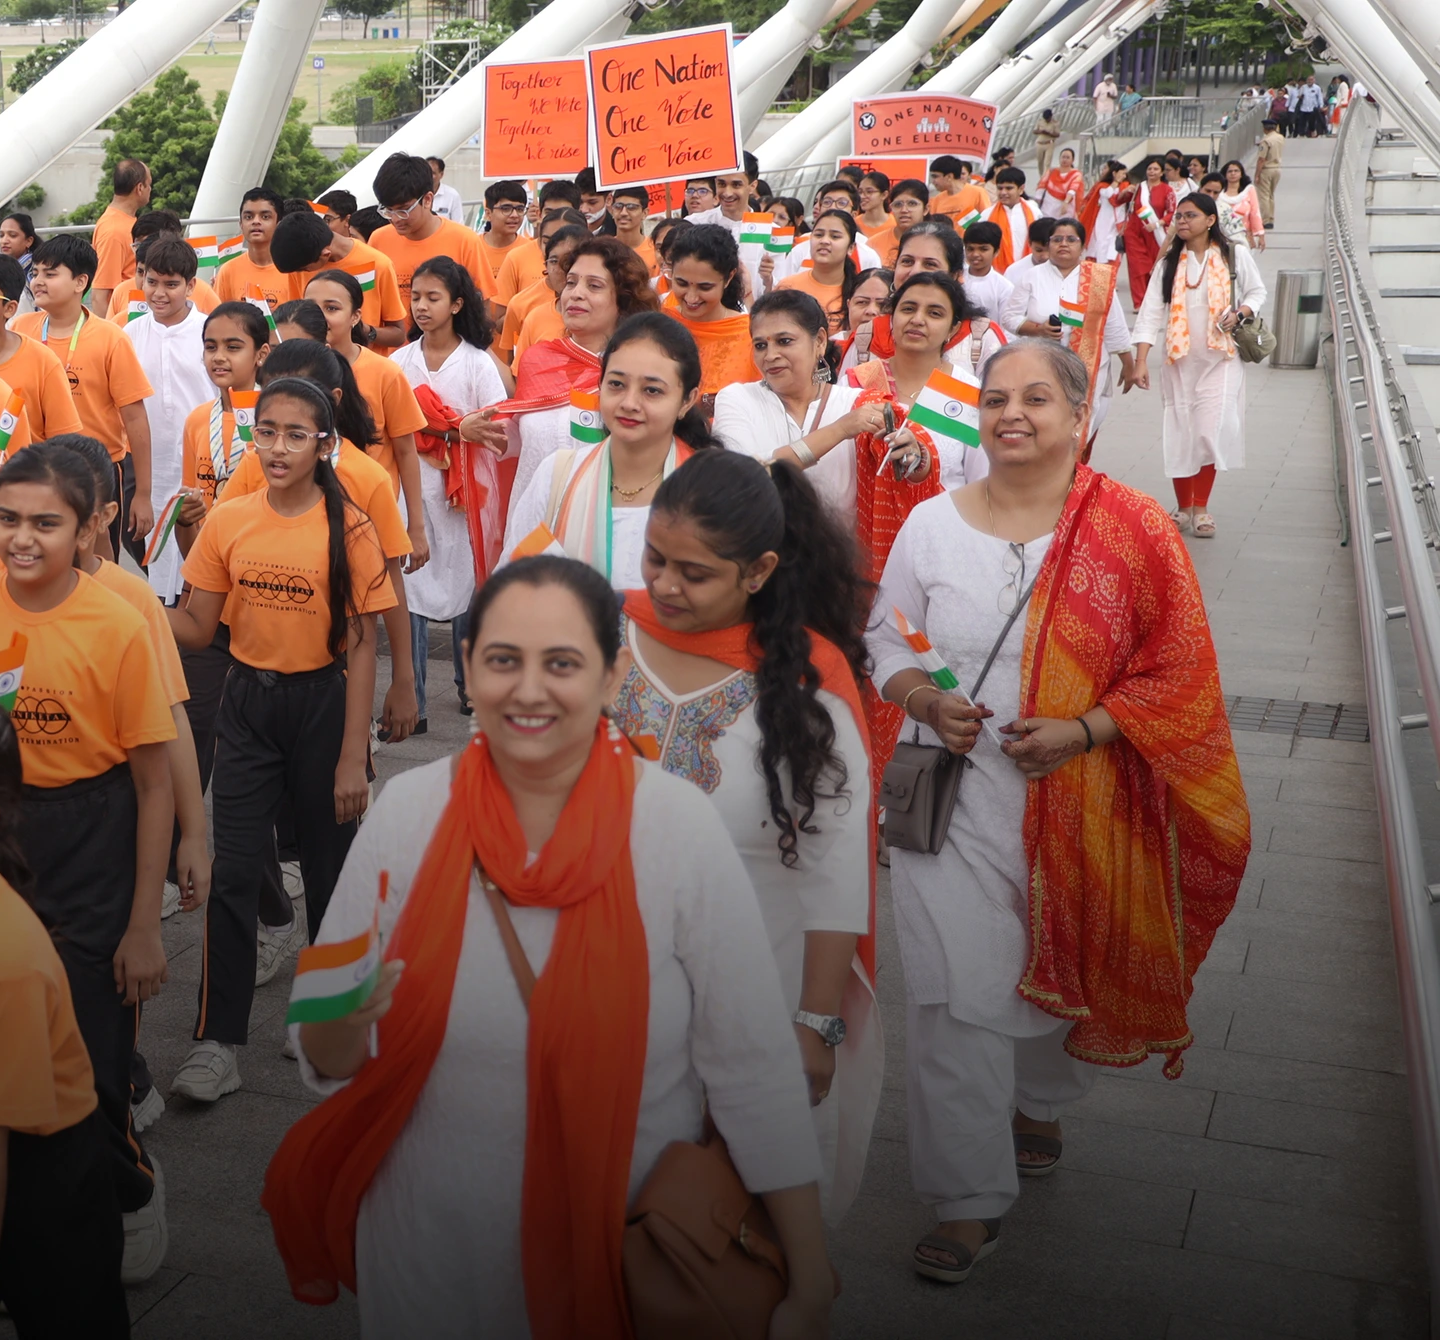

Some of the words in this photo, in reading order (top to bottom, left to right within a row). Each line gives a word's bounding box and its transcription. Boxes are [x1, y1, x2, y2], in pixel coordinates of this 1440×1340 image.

[496, 70, 563, 100] Together
[602, 59, 645, 93] One
[654, 53, 724, 87] Nation
[529, 97, 551, 115] We
[605, 105, 650, 138] One
[658, 91, 714, 126] Vote
[884, 107, 914, 127] ONE
[923, 104, 978, 128] NATION
[495, 118, 552, 144] Together
[871, 135, 902, 148] ONE
[913, 133, 987, 147] ELECTION
[610, 146, 647, 175] One
[659, 138, 713, 168] Voice
